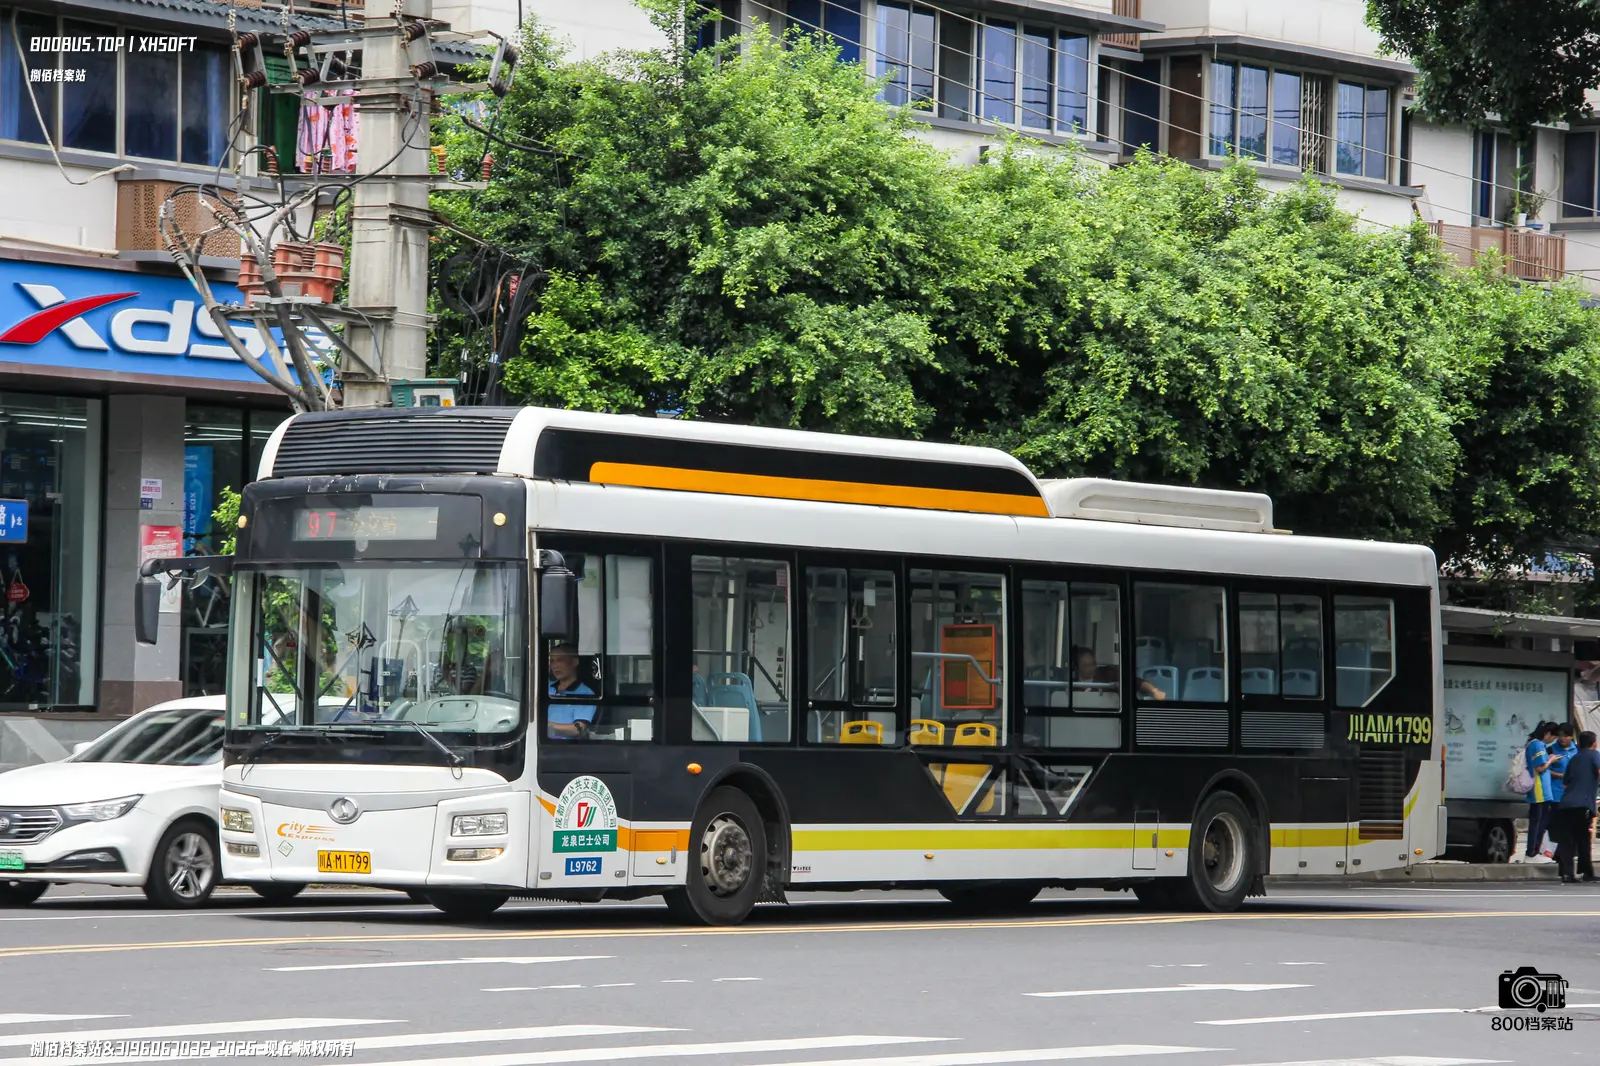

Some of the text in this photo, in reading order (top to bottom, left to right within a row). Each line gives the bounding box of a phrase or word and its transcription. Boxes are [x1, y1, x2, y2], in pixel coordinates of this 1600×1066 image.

[308, 511, 337, 538] 97
[277, 822, 305, 837] City
[561, 834, 610, 847] 龙泉巴士公司
[569, 860, 597, 873] L9762
